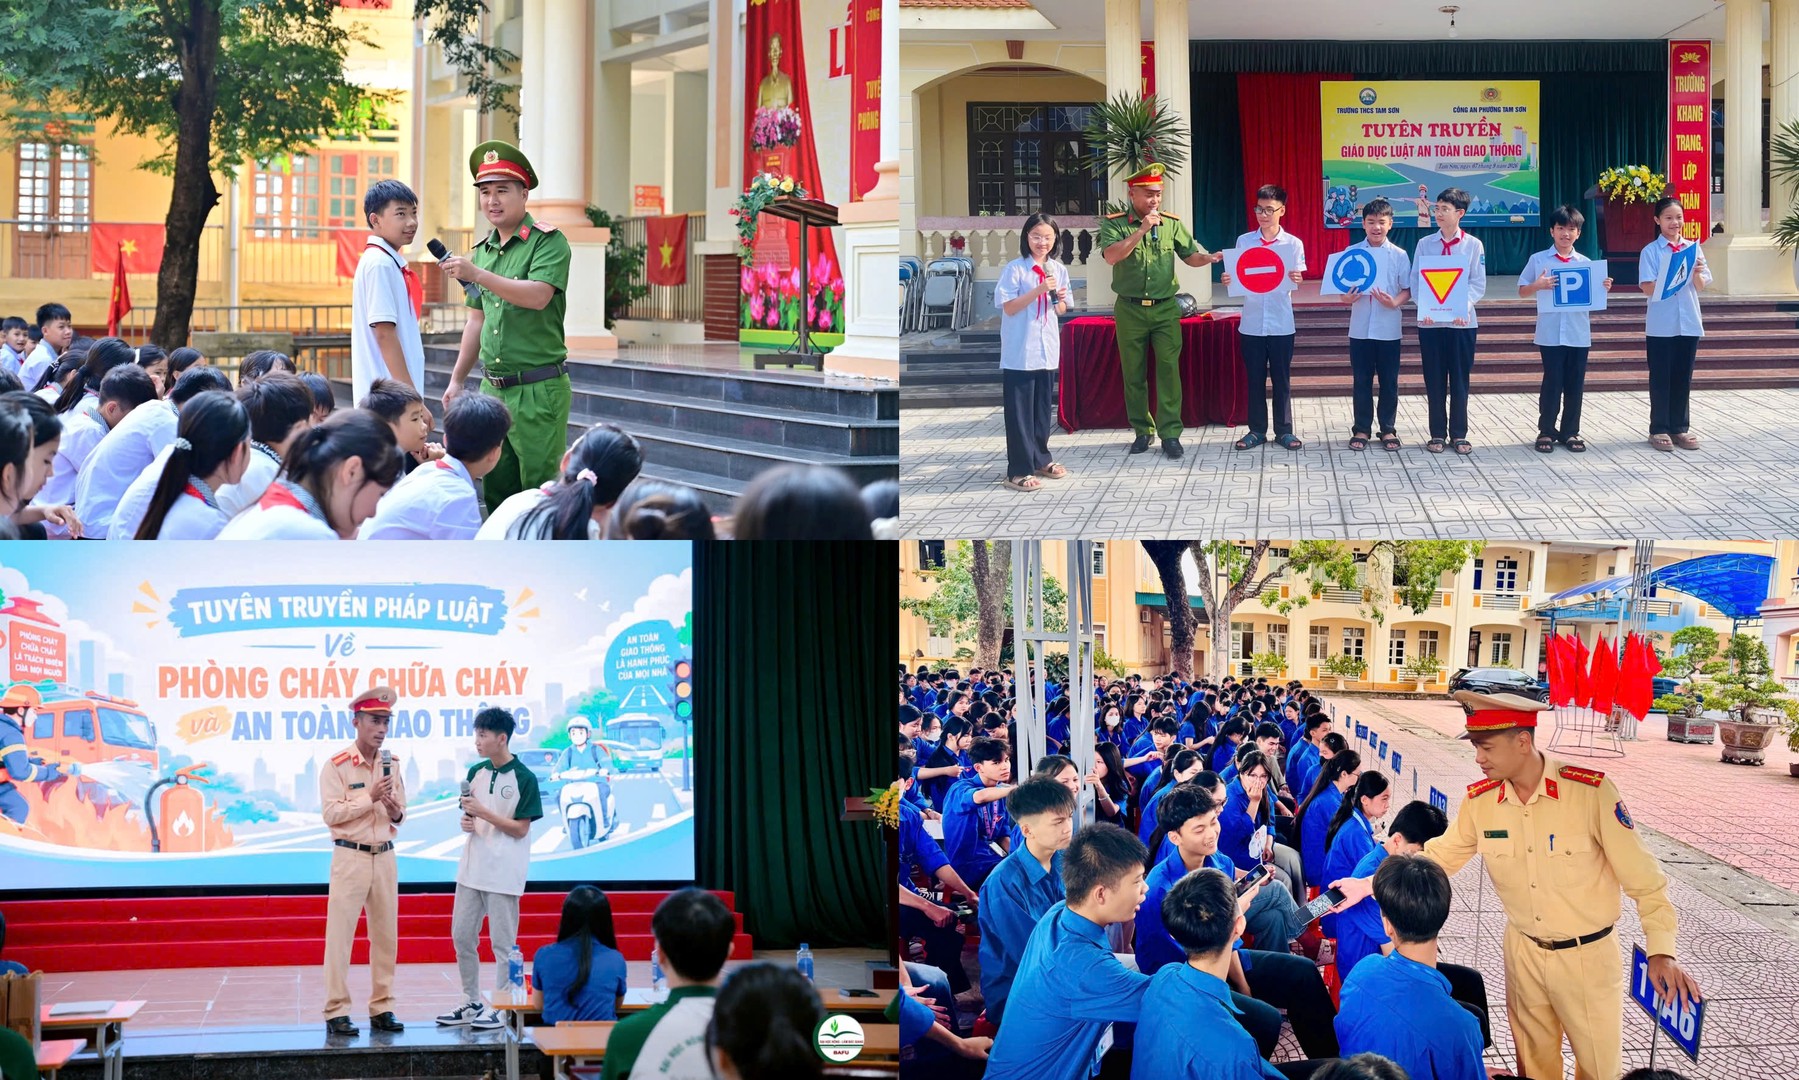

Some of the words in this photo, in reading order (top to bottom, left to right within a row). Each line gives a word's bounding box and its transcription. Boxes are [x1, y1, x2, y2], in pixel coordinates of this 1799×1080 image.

[1675, 71, 1705, 93] TRƯỜNG
[1337, 106, 1358, 114] TRƯỜNG
[1388, 106, 1400, 114] SƠN
[1677, 105, 1703, 122] KHANG
[1361, 119, 1423, 137] TUYÊN
[1427, 116, 1502, 137] TRUYỀN
[1341, 143, 1364, 158] GIÁO
[1367, 145, 1387, 160] DỤC
[1390, 142, 1414, 160] LUẬT
[1417, 145, 1431, 157] AN
[1434, 142, 1460, 157] TOÀN
[1463, 144, 1486, 157] GIAO
[1489, 142, 1522, 157] THÔNG
[1676, 134, 1704, 153] TRANG,
[1682, 160, 1697, 180] LỚP
[1680, 189, 1700, 209] THÂN
[1680, 218, 1701, 242] HIỆN
[1560, 272, 1583, 303] P
[188, 592, 272, 625] TUYÊN
[279, 588, 367, 618] TRUYỀN
[374, 593, 431, 619] PHÁP
[437, 596, 493, 629] LUẬT
[325, 632, 356, 657] Về
[620, 646, 639, 657] GIAO
[641, 643, 665, 654] THÔNG
[627, 635, 637, 645] AN
[159, 659, 268, 699] PHÒNG
[279, 660, 359, 699] CHÁY
[368, 661, 446, 697] CHỮA
[455, 660, 528, 697] CHÁY
[191, 711, 221, 735] và
[231, 711, 272, 741] AN
[281, 704, 356, 741] TOÀN
[386, 709, 432, 738] IAO
[440, 702, 530, 737] THG
